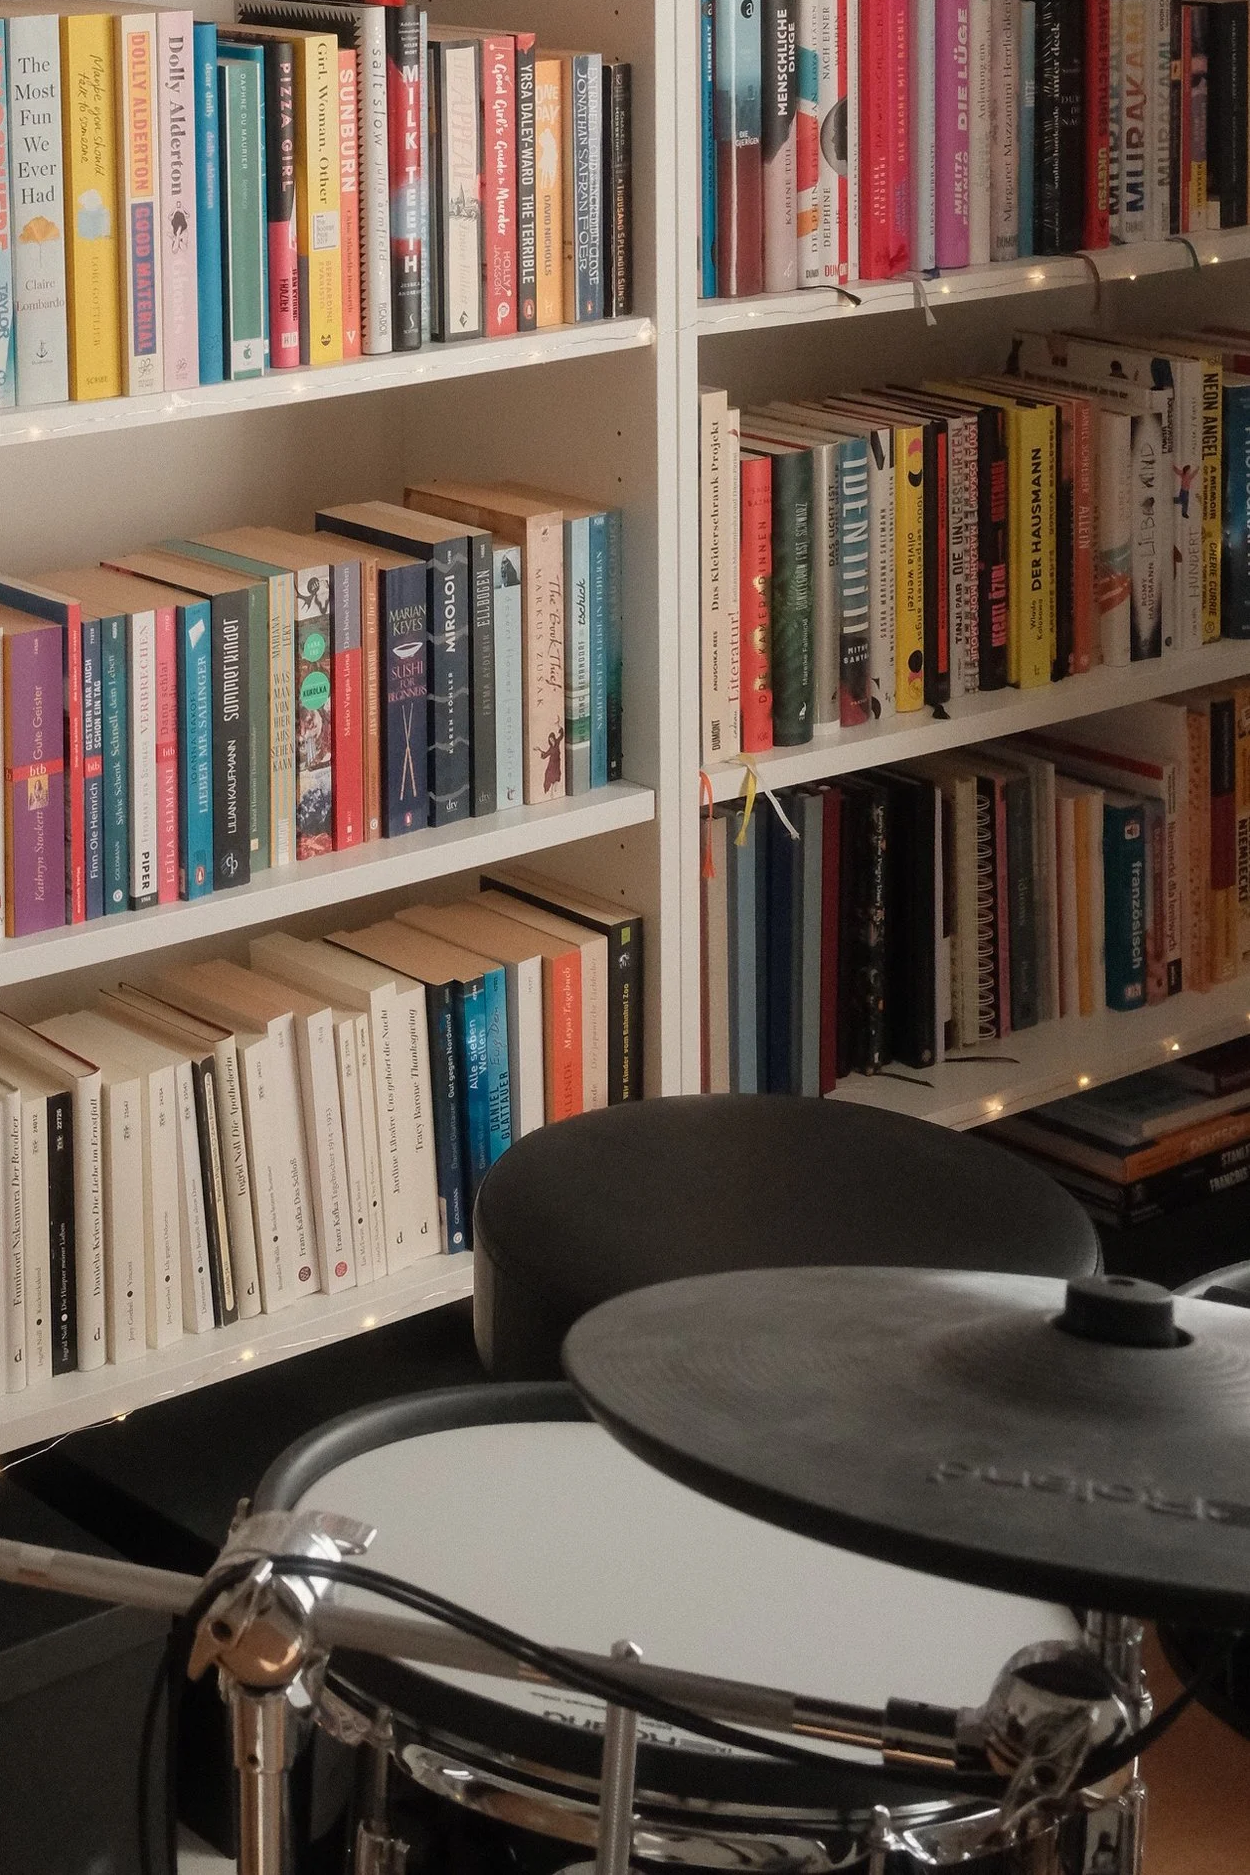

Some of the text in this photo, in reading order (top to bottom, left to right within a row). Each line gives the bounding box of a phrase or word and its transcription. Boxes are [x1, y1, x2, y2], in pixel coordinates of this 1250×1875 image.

[19, 58, 50, 74] The
[777, 9, 788, 116] MENSCHLICHE
[15, 84, 55, 101] Most
[20, 110, 53, 125] Fun
[169, 36, 185, 196] Dolly Alderton
[340, 69, 355, 193] SUNBURN
[24, 137, 50, 152] We
[18, 162, 57, 180] Ever
[21, 186, 55, 204] Had
[1031, 446, 1042, 592] DER HAUSMANN
[388, 604, 427, 623] MARIAN
[445, 576, 455, 653] MIROLOI
[392, 618, 423, 636] KEYES
[711, 719, 721, 751] DUMONT
[141, 851, 150, 890] PIPER
[1131, 860, 1144, 969] französisch
